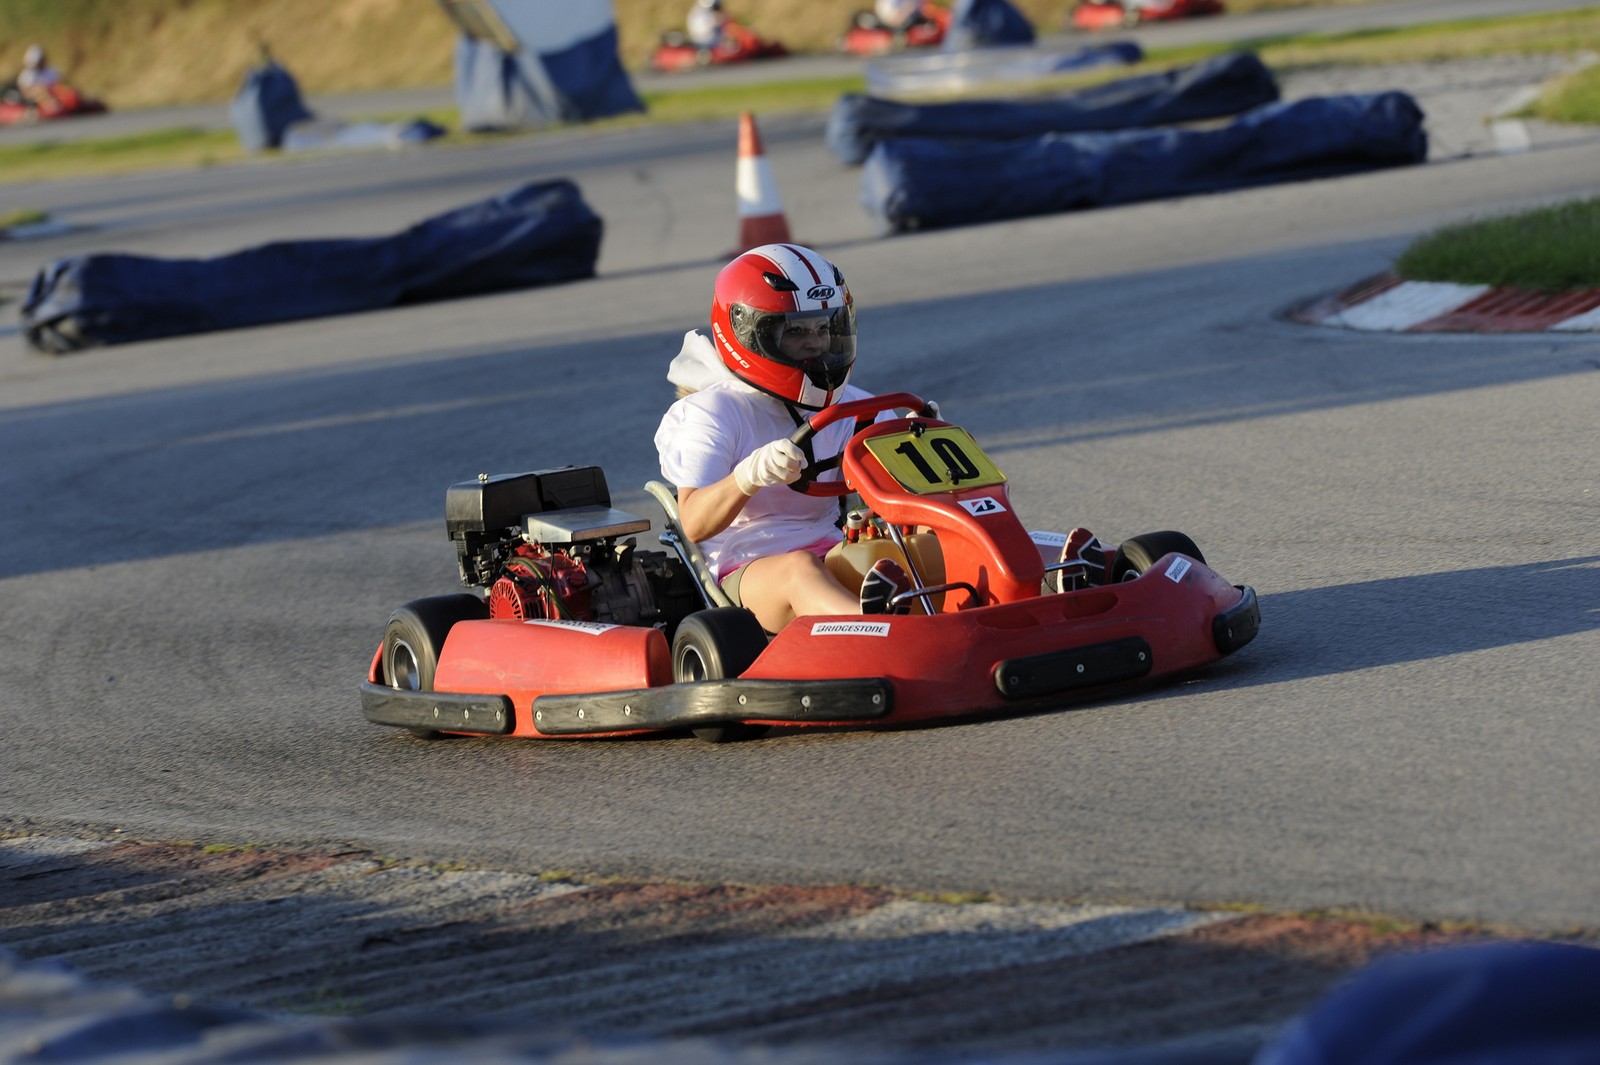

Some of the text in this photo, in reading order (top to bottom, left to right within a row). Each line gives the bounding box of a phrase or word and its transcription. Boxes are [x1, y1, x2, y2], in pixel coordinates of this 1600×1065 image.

[713, 322, 751, 369] SPEED
[894, 438, 980, 484] 10
[816, 624, 886, 634] BRIDGESTONE
